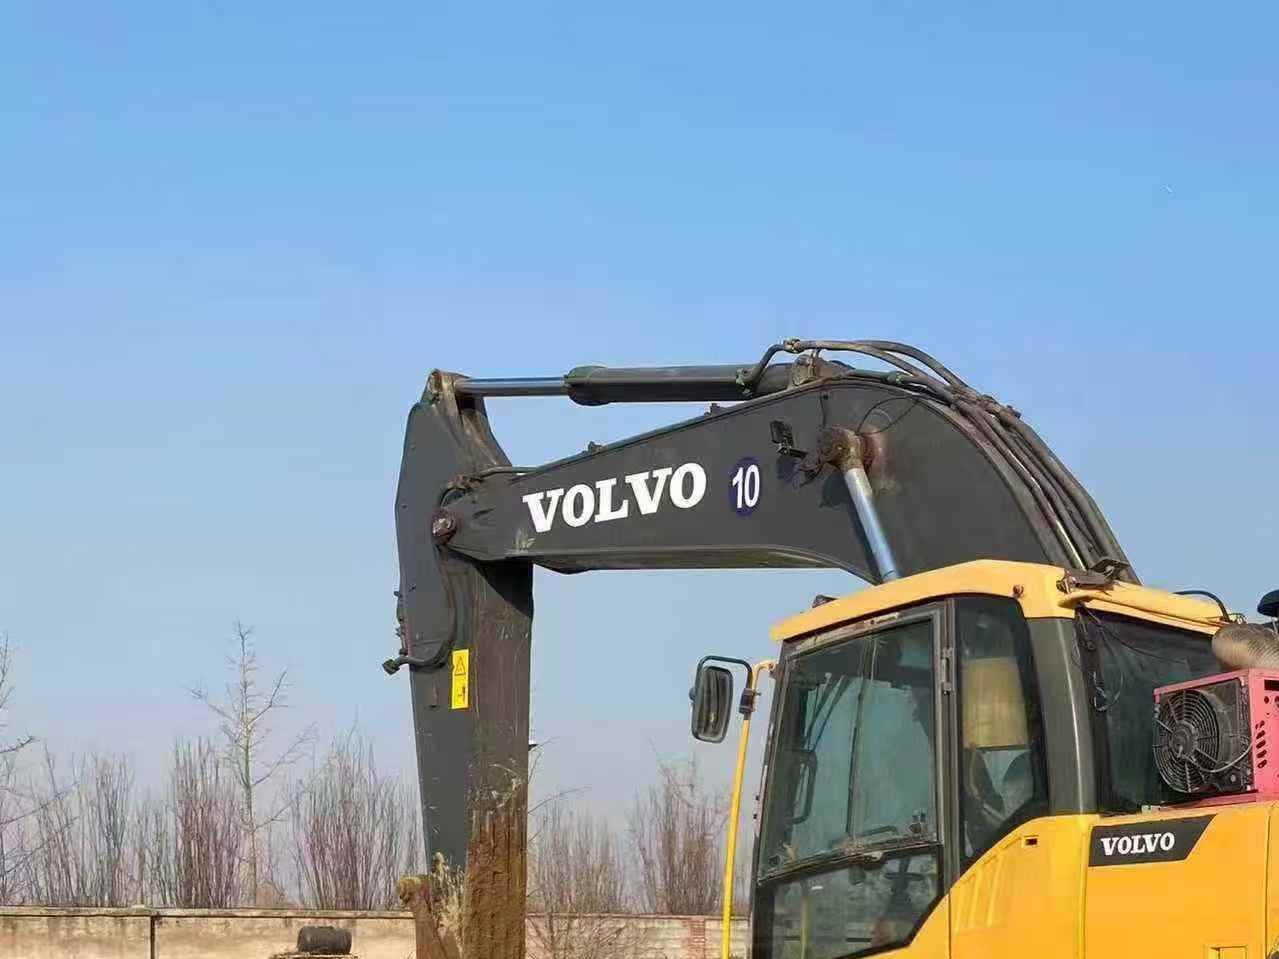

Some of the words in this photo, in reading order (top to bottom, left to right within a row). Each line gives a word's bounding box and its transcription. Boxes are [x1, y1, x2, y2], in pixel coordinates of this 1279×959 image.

[522, 462, 707, 533] VOLVO
[732, 464, 760, 508] 10
[1100, 832, 1175, 856] VOLVO
